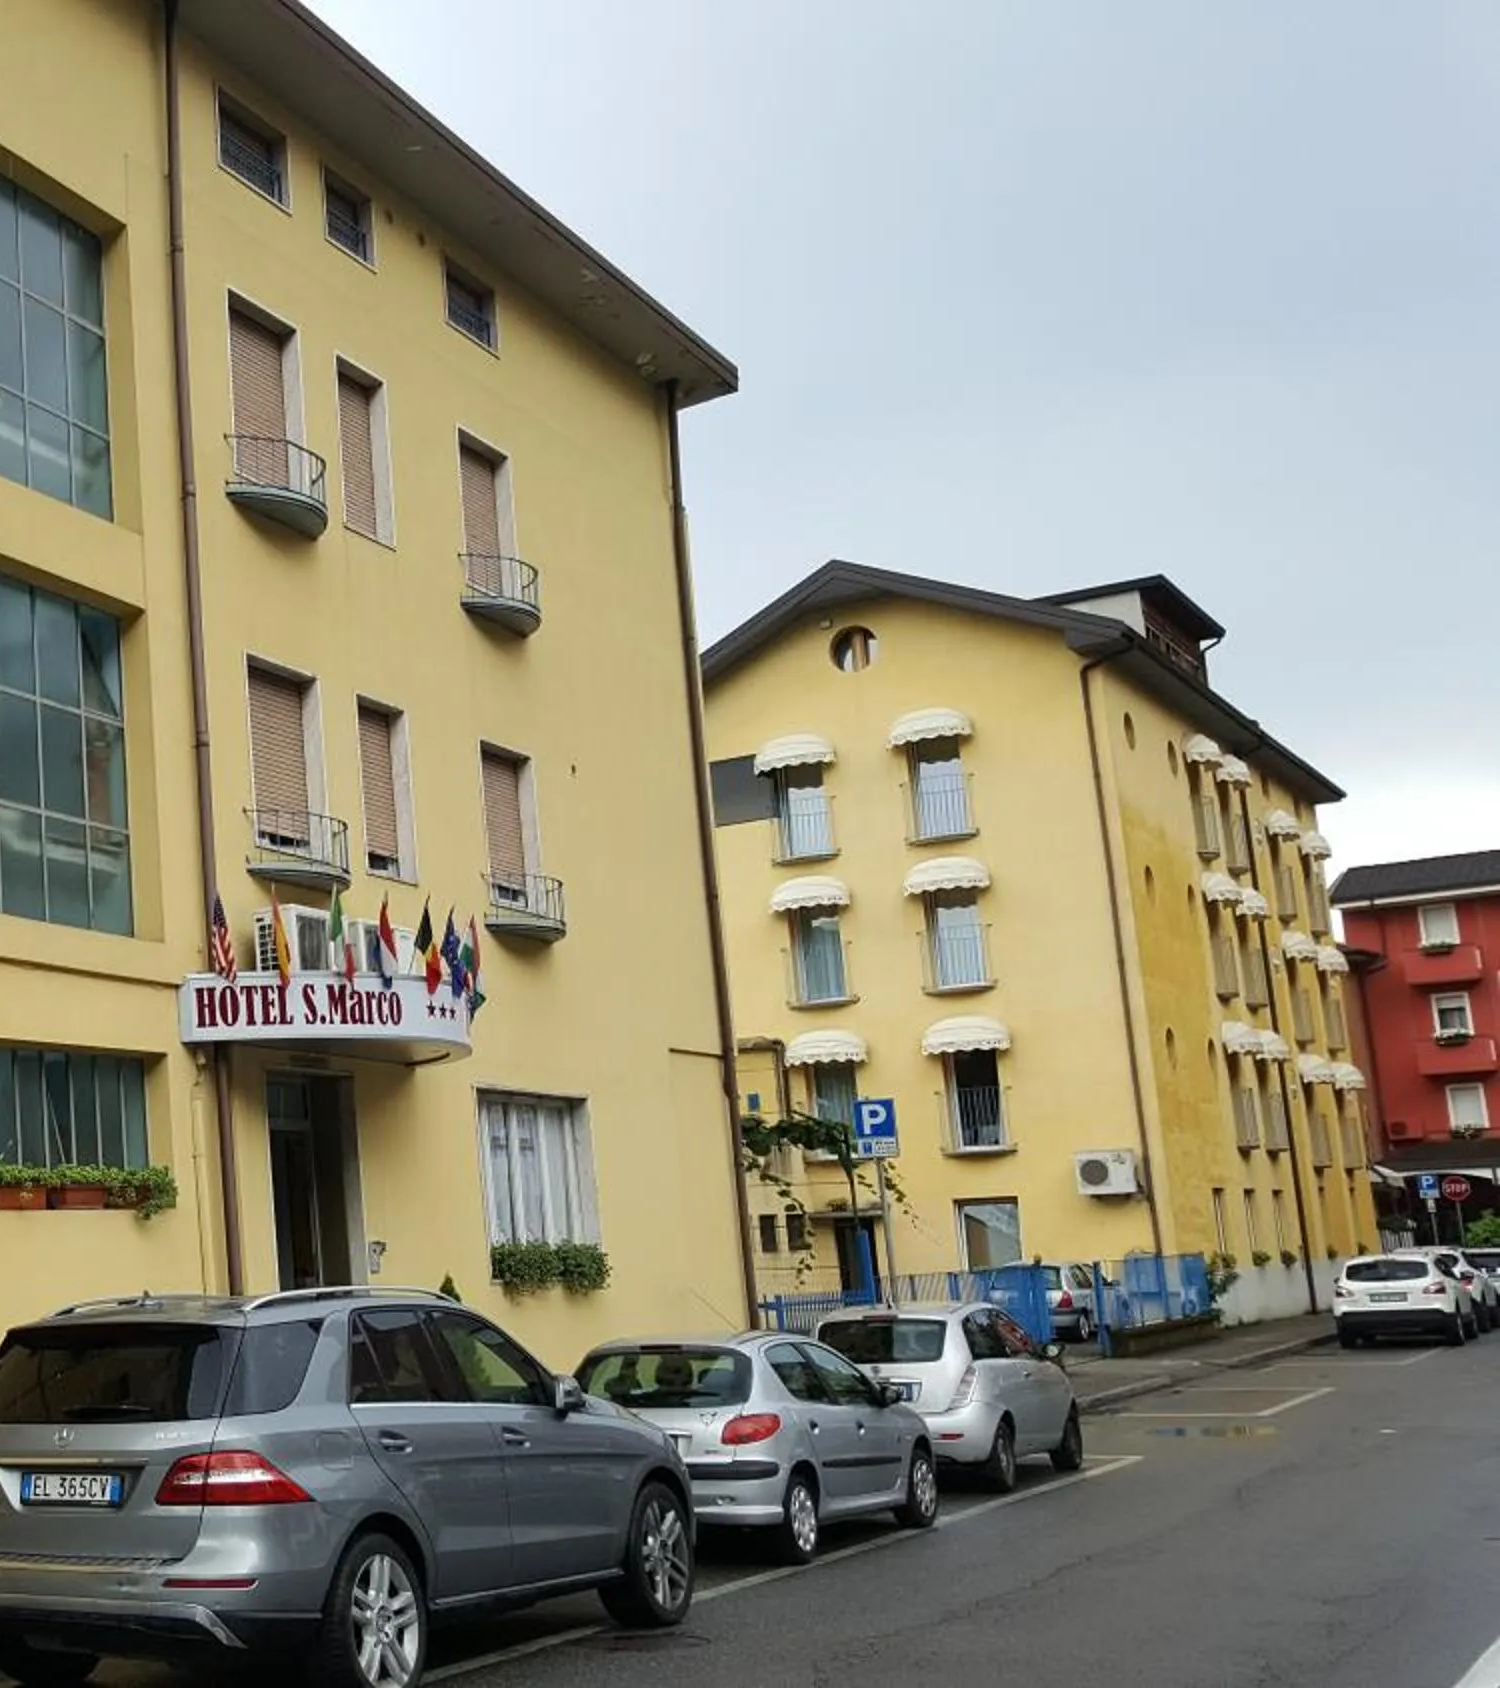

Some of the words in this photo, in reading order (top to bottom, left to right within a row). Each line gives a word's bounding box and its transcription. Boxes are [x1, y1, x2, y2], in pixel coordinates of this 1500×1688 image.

[195, 985, 293, 1027] HOTEL
[861, 1103, 887, 1134] P
[1421, 1175, 1434, 1189] P
[1445, 1183, 1468, 1193] STOP
[33, 1476, 51, 1497] EL
[57, 1477, 109, 1499] 365CV
